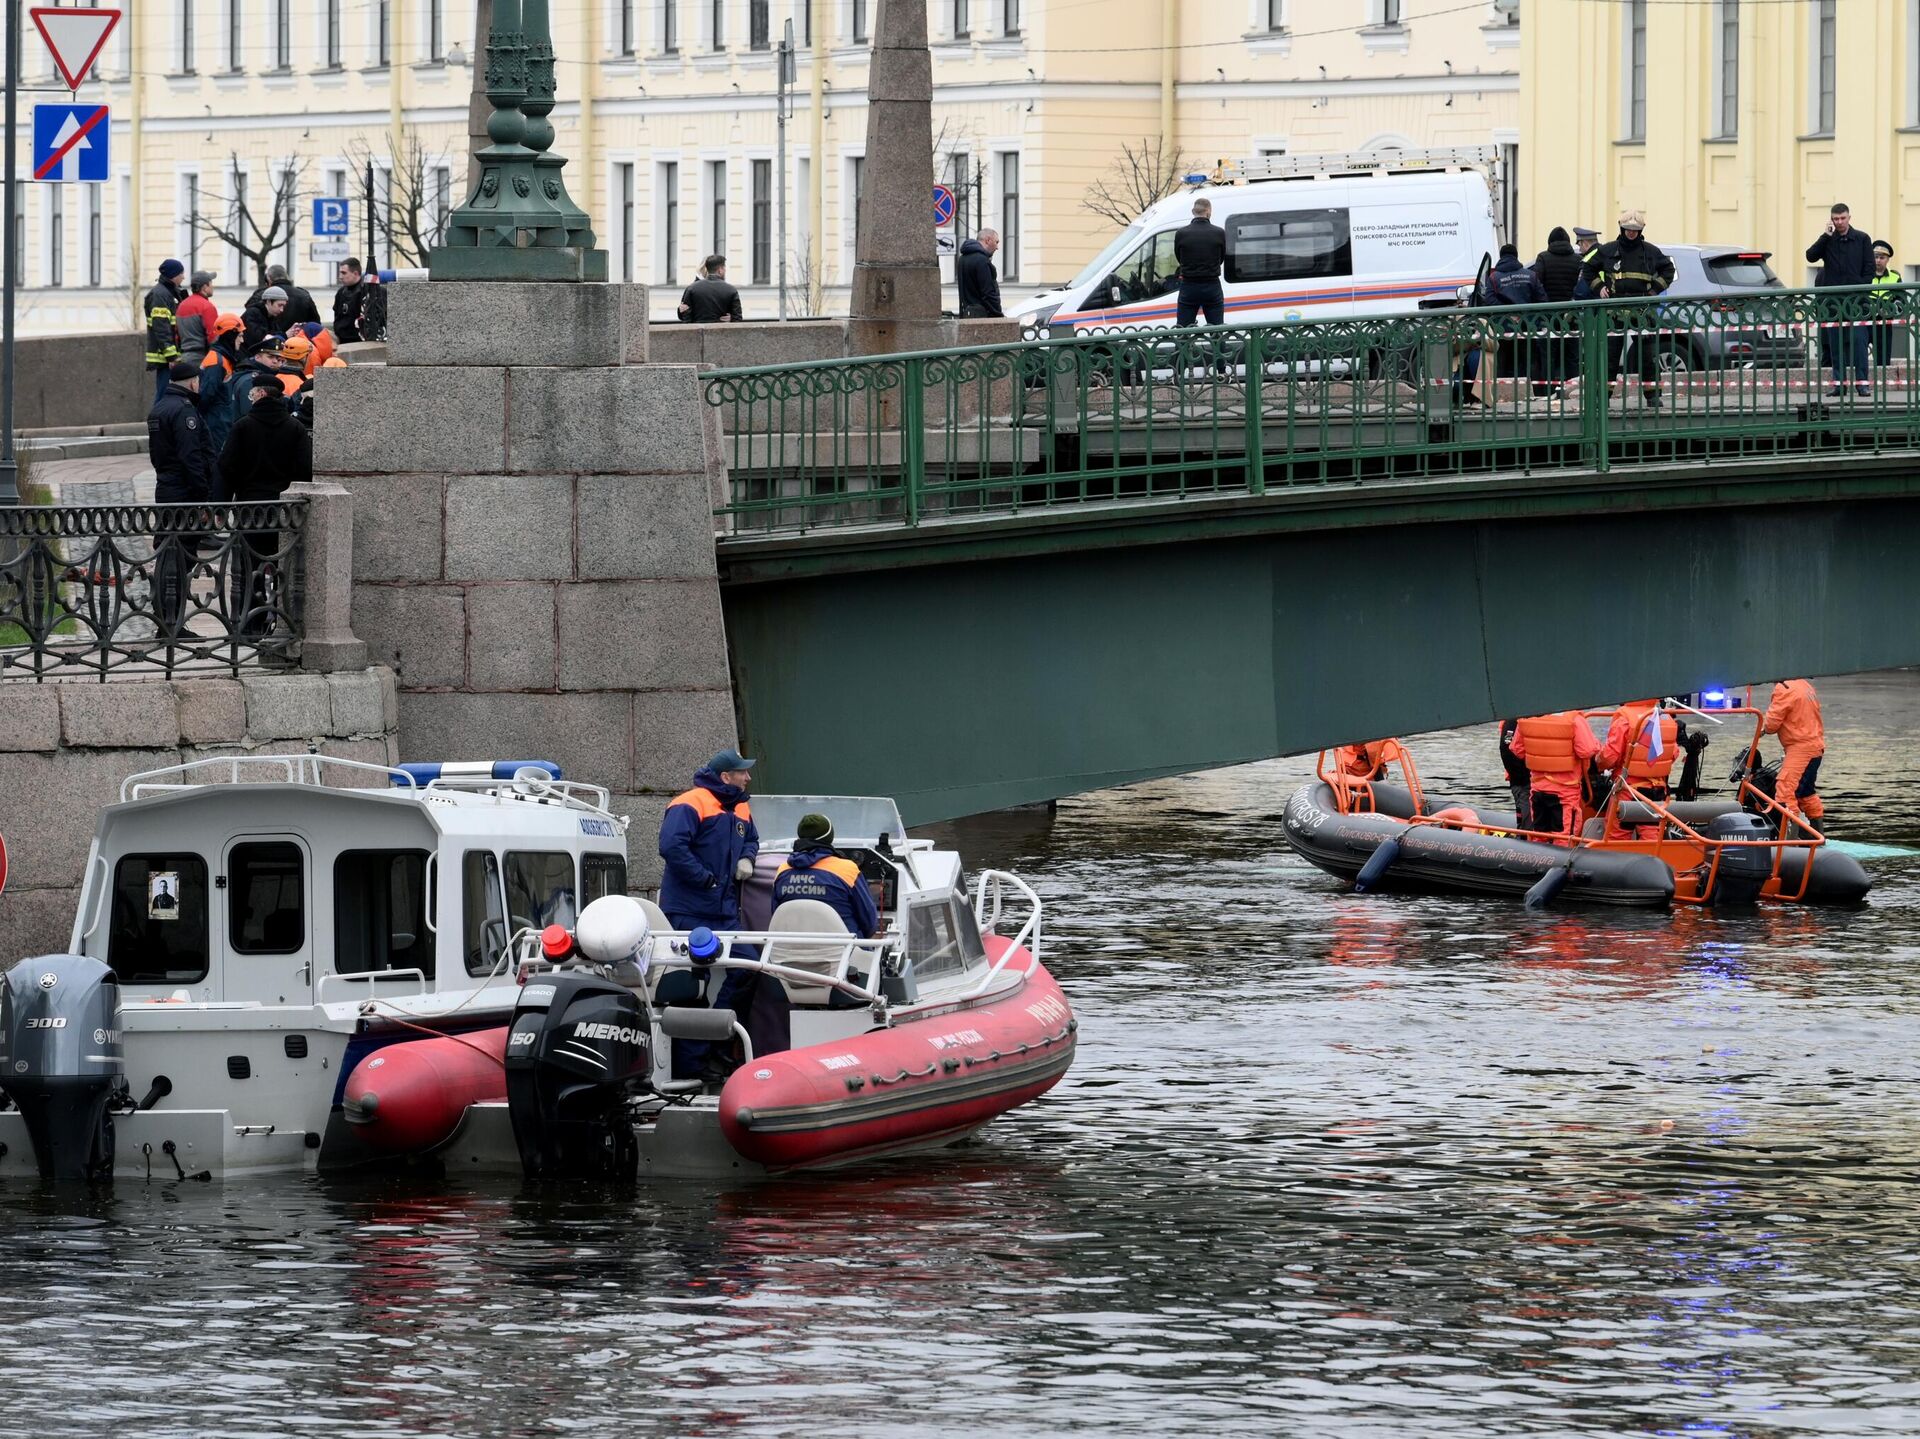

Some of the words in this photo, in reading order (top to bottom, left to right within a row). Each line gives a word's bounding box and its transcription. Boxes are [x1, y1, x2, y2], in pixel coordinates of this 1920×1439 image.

[322, 202, 343, 232] P
[1353, 224, 1409, 232] СЕВЕРО-ЗАПАДНЫЙ
[1355, 231, 1436, 240] ПОИСКОВО-СПАСАТЕЛЬНЫЙ
[1720, 834, 1748, 842] YAMAHA
[1440, 842, 1474, 856] служба
[789, 874, 815, 884] МЧС
[781, 885, 826, 895] РОССИИ
[25, 1017, 67, 1029] 300
[509, 1032, 536, 1046] 150
[573, 1021, 651, 1049] MERCURY
